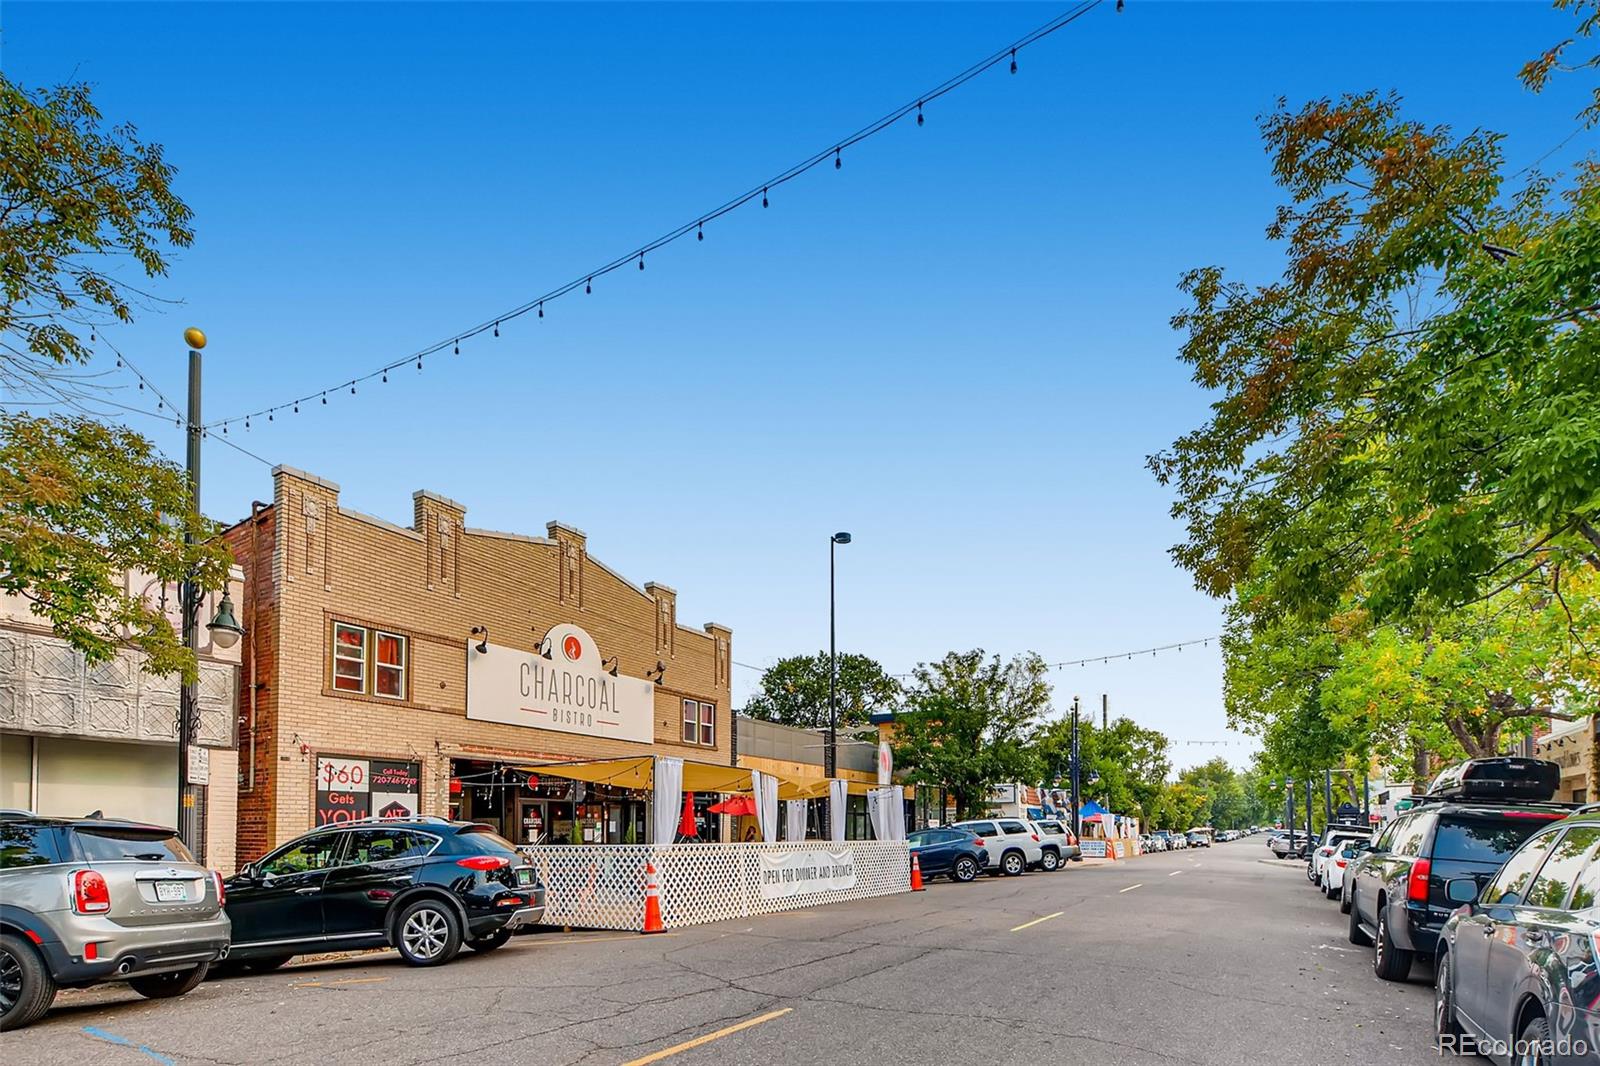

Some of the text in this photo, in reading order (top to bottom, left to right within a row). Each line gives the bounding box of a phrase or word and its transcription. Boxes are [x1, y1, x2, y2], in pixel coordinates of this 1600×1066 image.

[520, 662, 620, 714] CHARCOAL
[552, 708, 592, 728] BISTRO
[323, 762, 363, 785] $60
[328, 792, 355, 805] Gets
[320, 809, 367, 828] YOU
[763, 863, 853, 885] OPEN FOR DINNER AND BRUNCH
